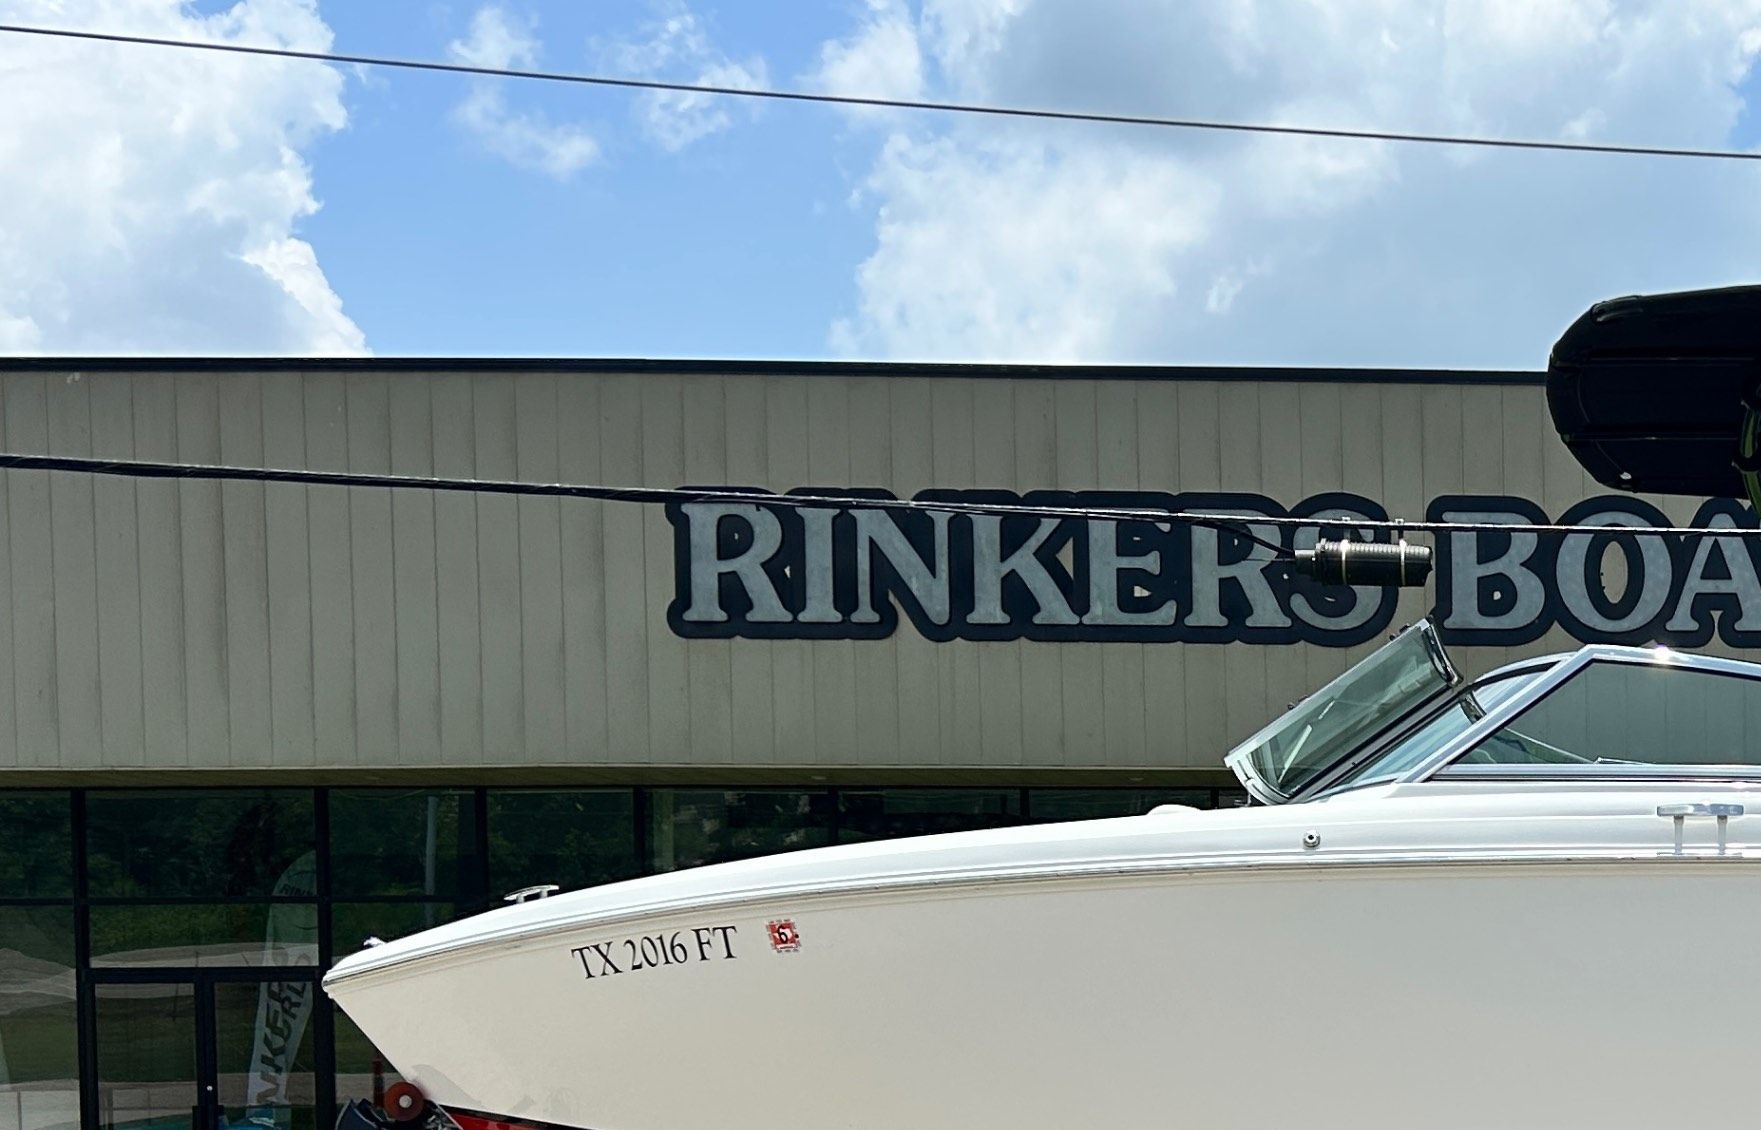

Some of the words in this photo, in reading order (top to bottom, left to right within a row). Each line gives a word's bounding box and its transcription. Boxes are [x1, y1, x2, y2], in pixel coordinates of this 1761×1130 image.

[678, 501, 1386, 632] RINKERS
[571, 941, 624, 980] TX
[623, 931, 689, 972] 2016
[691, 925, 738, 961] FT
